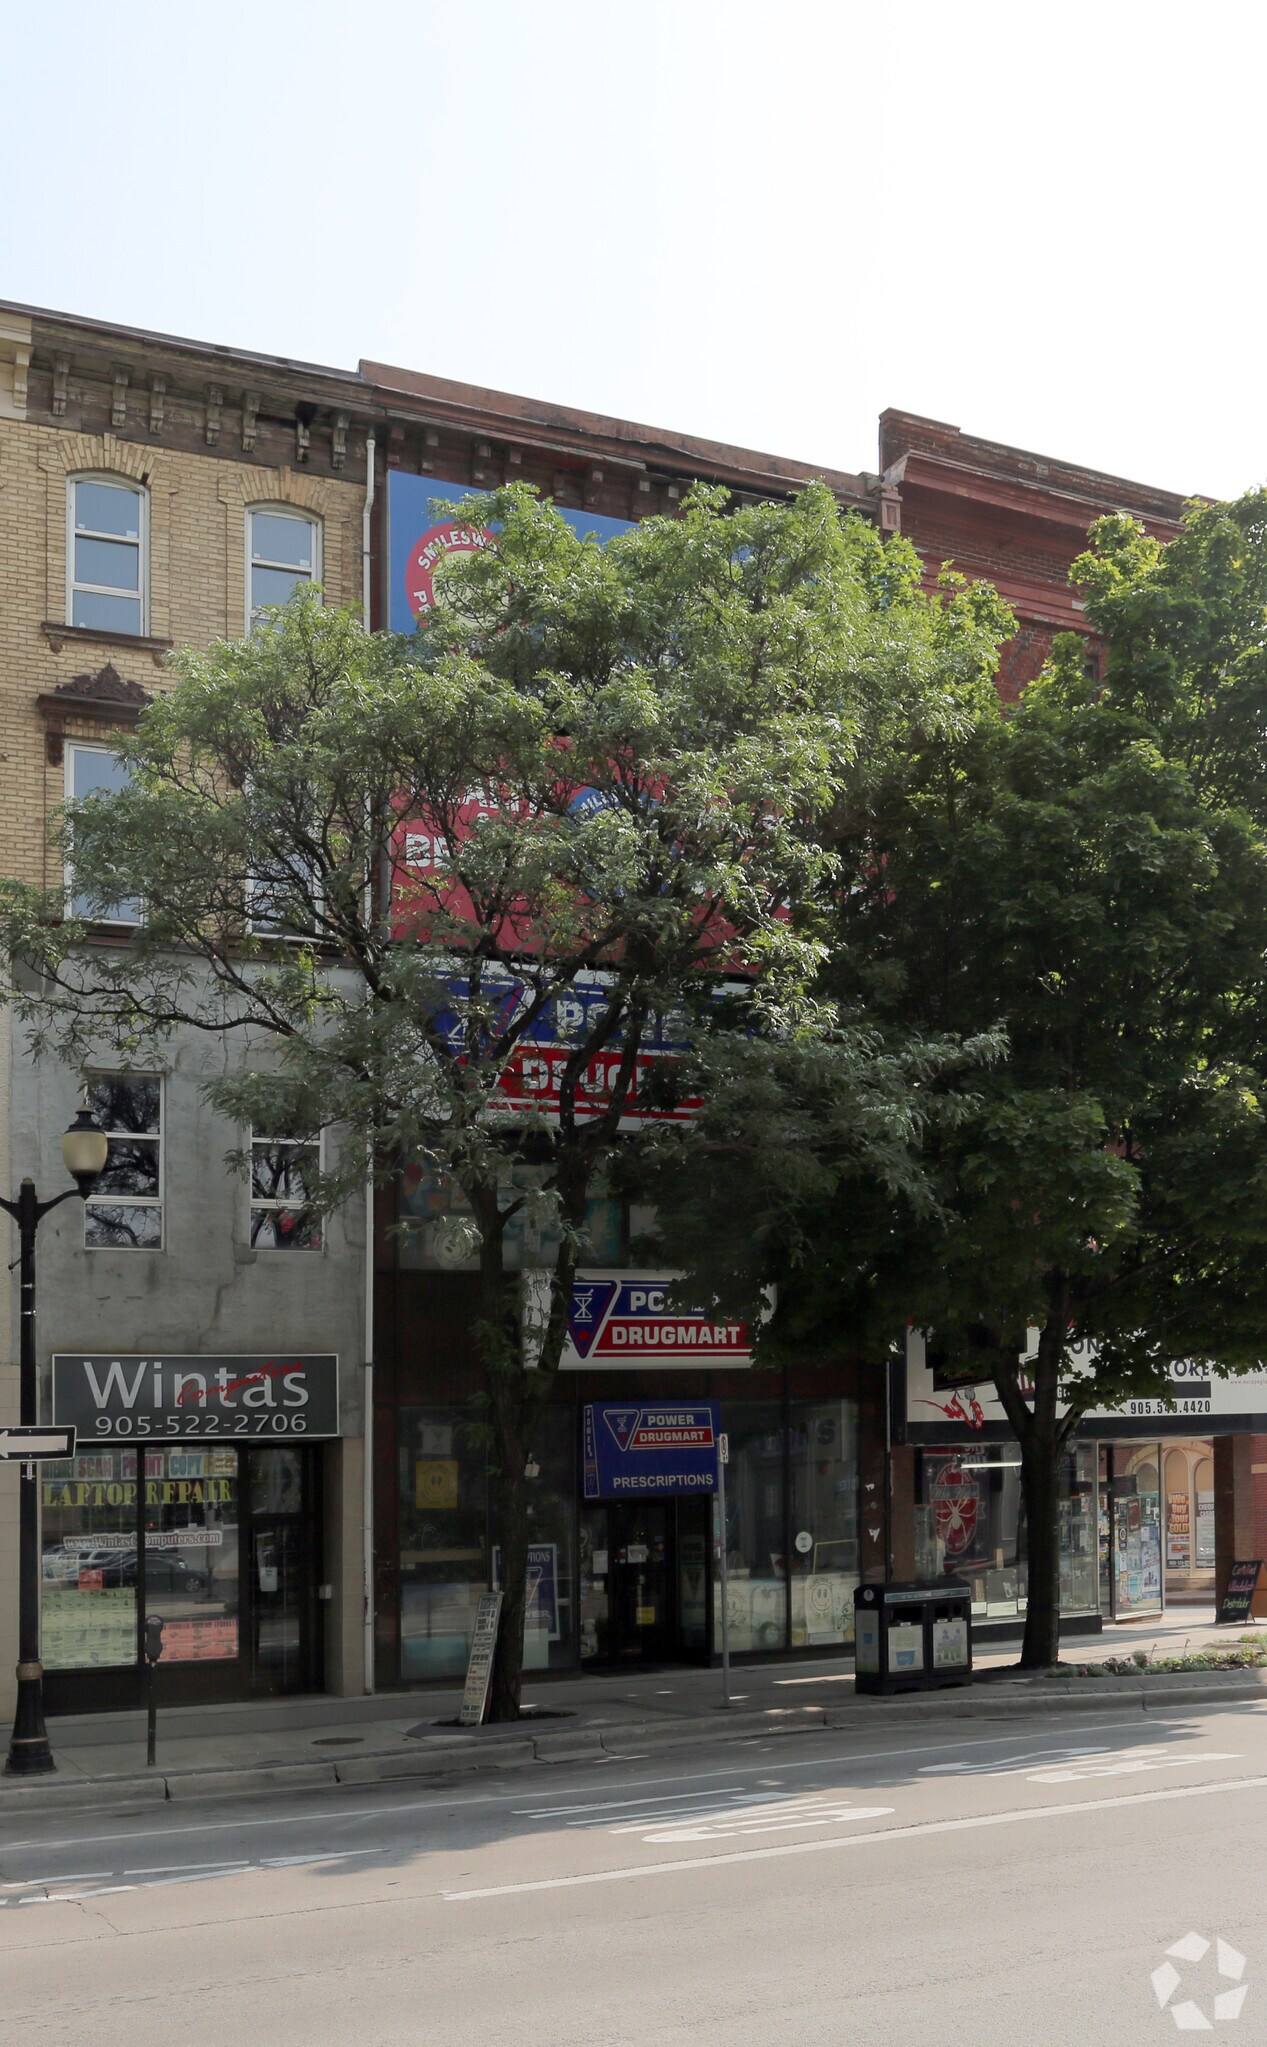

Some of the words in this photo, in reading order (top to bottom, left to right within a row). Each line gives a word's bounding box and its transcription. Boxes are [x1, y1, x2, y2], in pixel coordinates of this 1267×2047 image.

[612, 1326, 740, 1345] DRUGMART
[83, 1361, 310, 1409] Wintas
[95, 1413, 307, 1436] 905-522-2706
[647, 1415, 695, 1426] POWER
[639, 1431, 705, 1443] DRUGMART
[78, 1456, 113, 1478] SCAN
[170, 1455, 203, 1477] COPY
[613, 1474, 714, 1488] PRESCRIPTIONS
[42, 1483, 136, 1507] LAPTOP
[145, 1480, 232, 1505] REPAIR
[1169, 1523, 1190, 1533] GOLD
